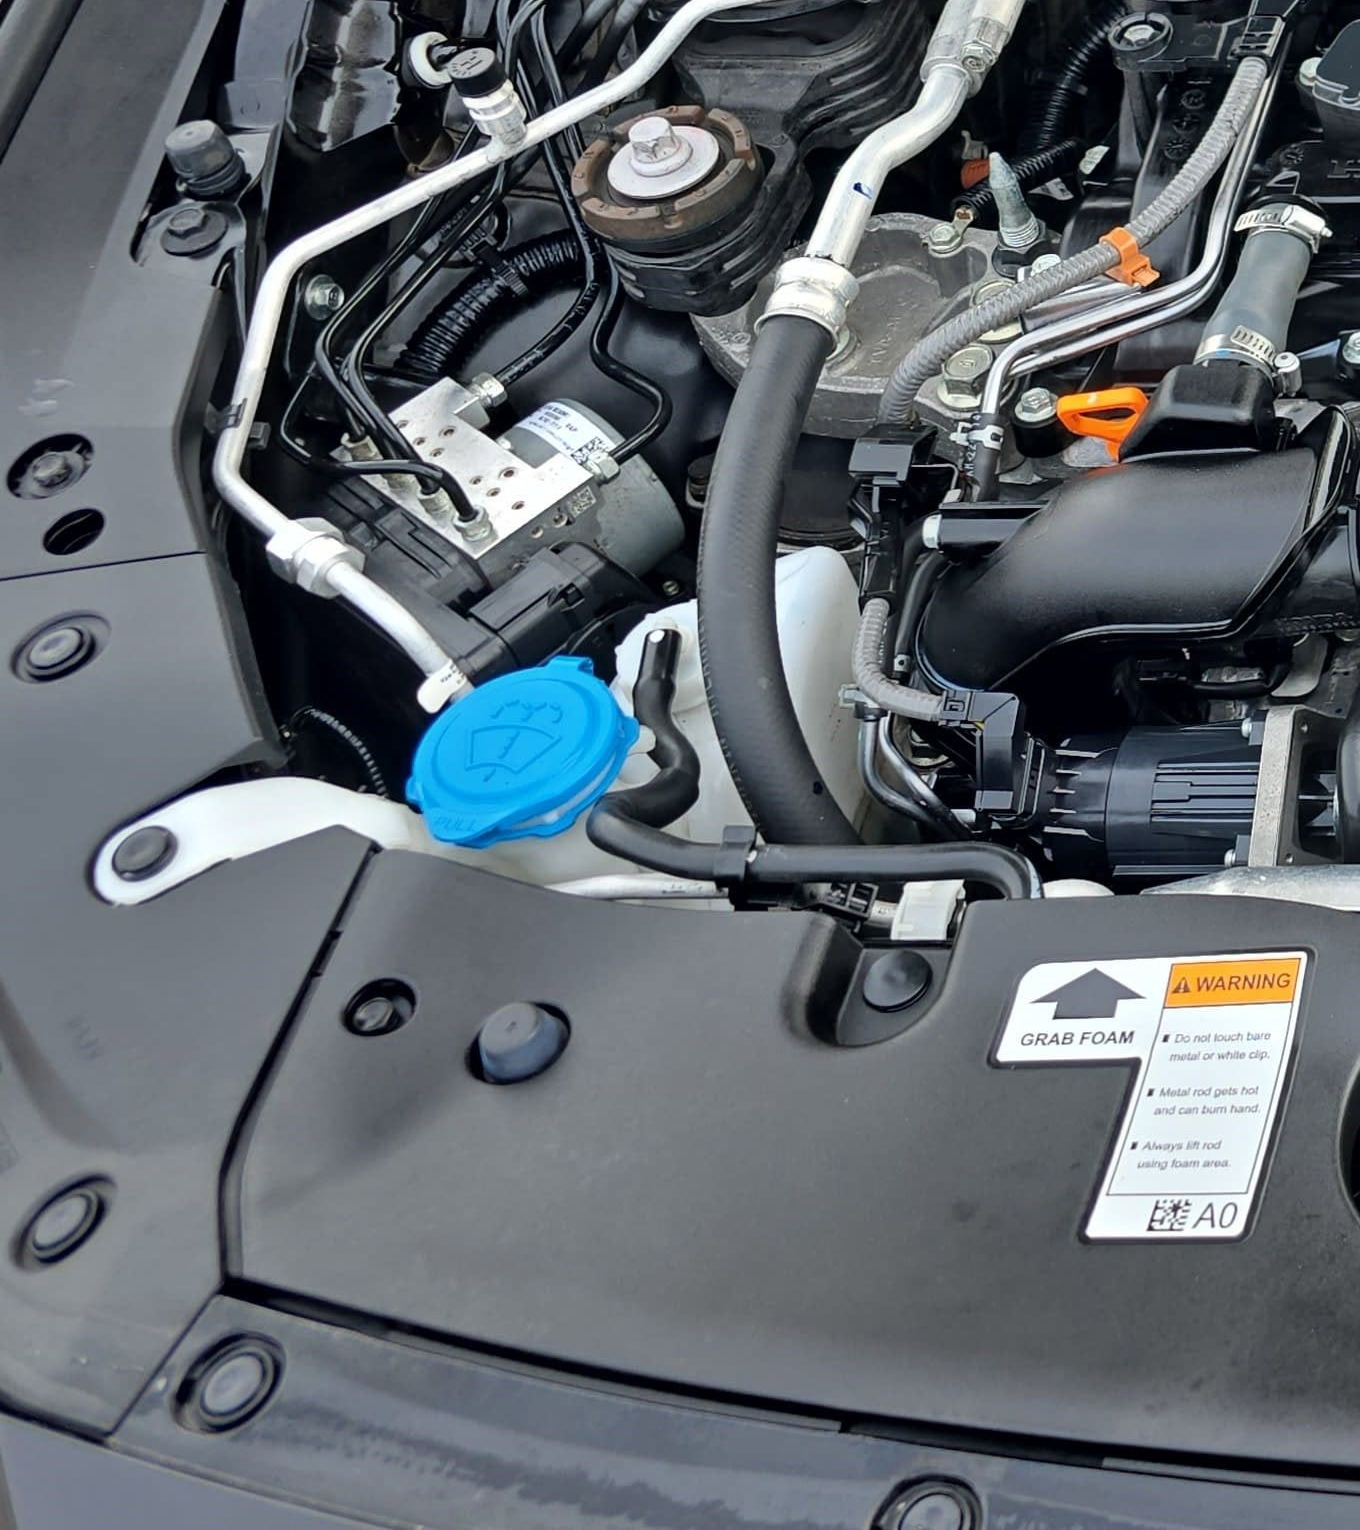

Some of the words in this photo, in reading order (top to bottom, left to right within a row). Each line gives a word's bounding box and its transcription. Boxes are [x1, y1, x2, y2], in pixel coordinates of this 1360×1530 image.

[1195, 973, 1292, 993] WARNING
[1020, 1031, 1074, 1047] GRAB
[1079, 1030, 1135, 1045] FOAM
[1174, 1033, 1191, 1043] Do
[1193, 1033, 1211, 1043] not
[1214, 1032, 1243, 1042] touch
[1246, 1031, 1271, 1041] bare
[1169, 1051, 1200, 1061] metal
[1202, 1052, 1215, 1061] or
[1217, 1050, 1246, 1060] white
[1248, 1049, 1270, 1061] clip.
[1159, 1087, 1191, 1097] Metal
[1192, 1086, 1212, 1096] rod
[1213, 1086, 1238, 1098] gets
[1240, 1086, 1259, 1095] hot
[1153, 1105, 1176, 1115] and
[1178, 1106, 1199, 1115] can
[1201, 1105, 1227, 1115] burn
[1229, 1104, 1260, 1114] hand.
[1142, 1140, 1183, 1152] Always
[1185, 1140, 1201, 1150] lift
[1202, 1140, 1222, 1150] rod
[1137, 1159, 1168, 1170] using
[1170, 1158, 1200, 1169] foam
